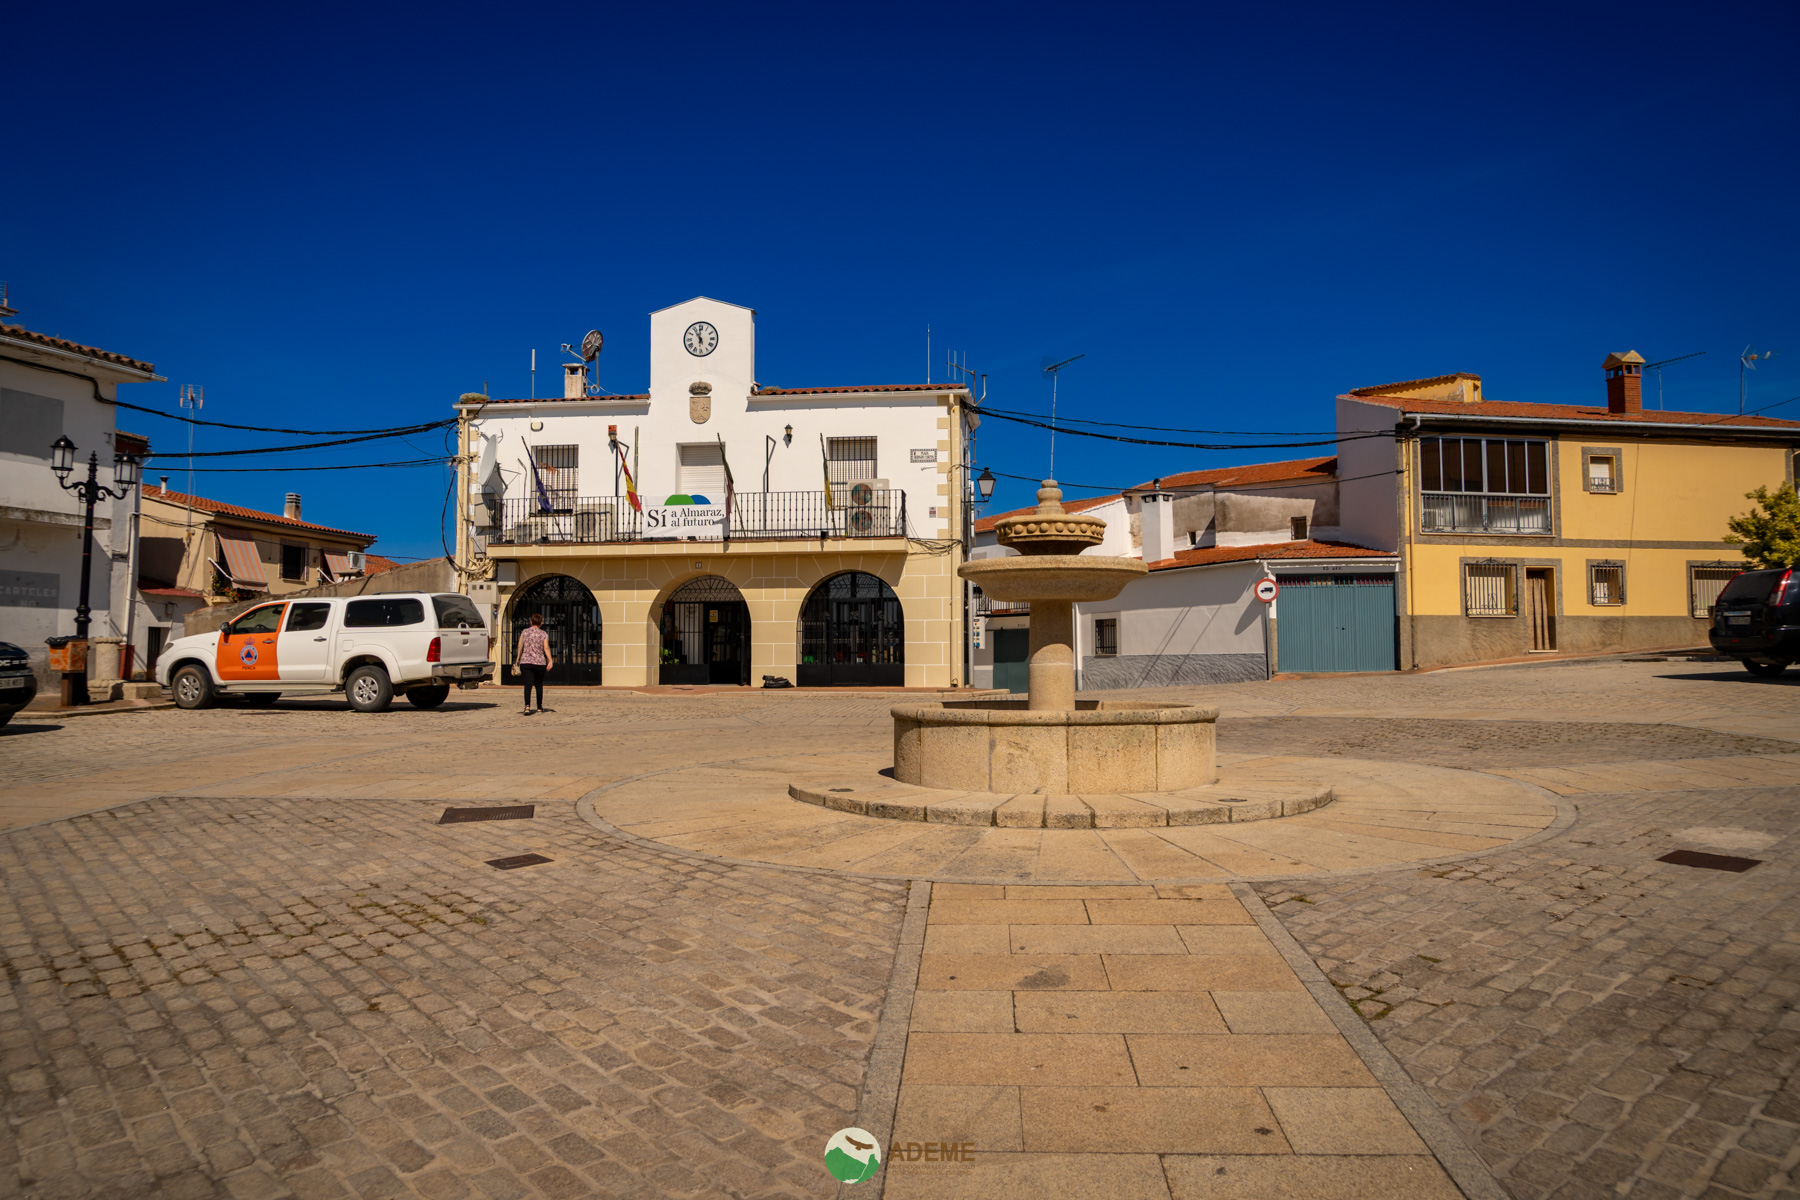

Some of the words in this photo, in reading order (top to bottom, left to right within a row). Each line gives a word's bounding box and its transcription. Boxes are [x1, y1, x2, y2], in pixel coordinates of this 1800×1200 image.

[647, 508, 667, 528] Sí
[670, 510, 677, 518] a
[680, 507, 725, 518] Almaraz,
[670, 517, 680, 527] al
